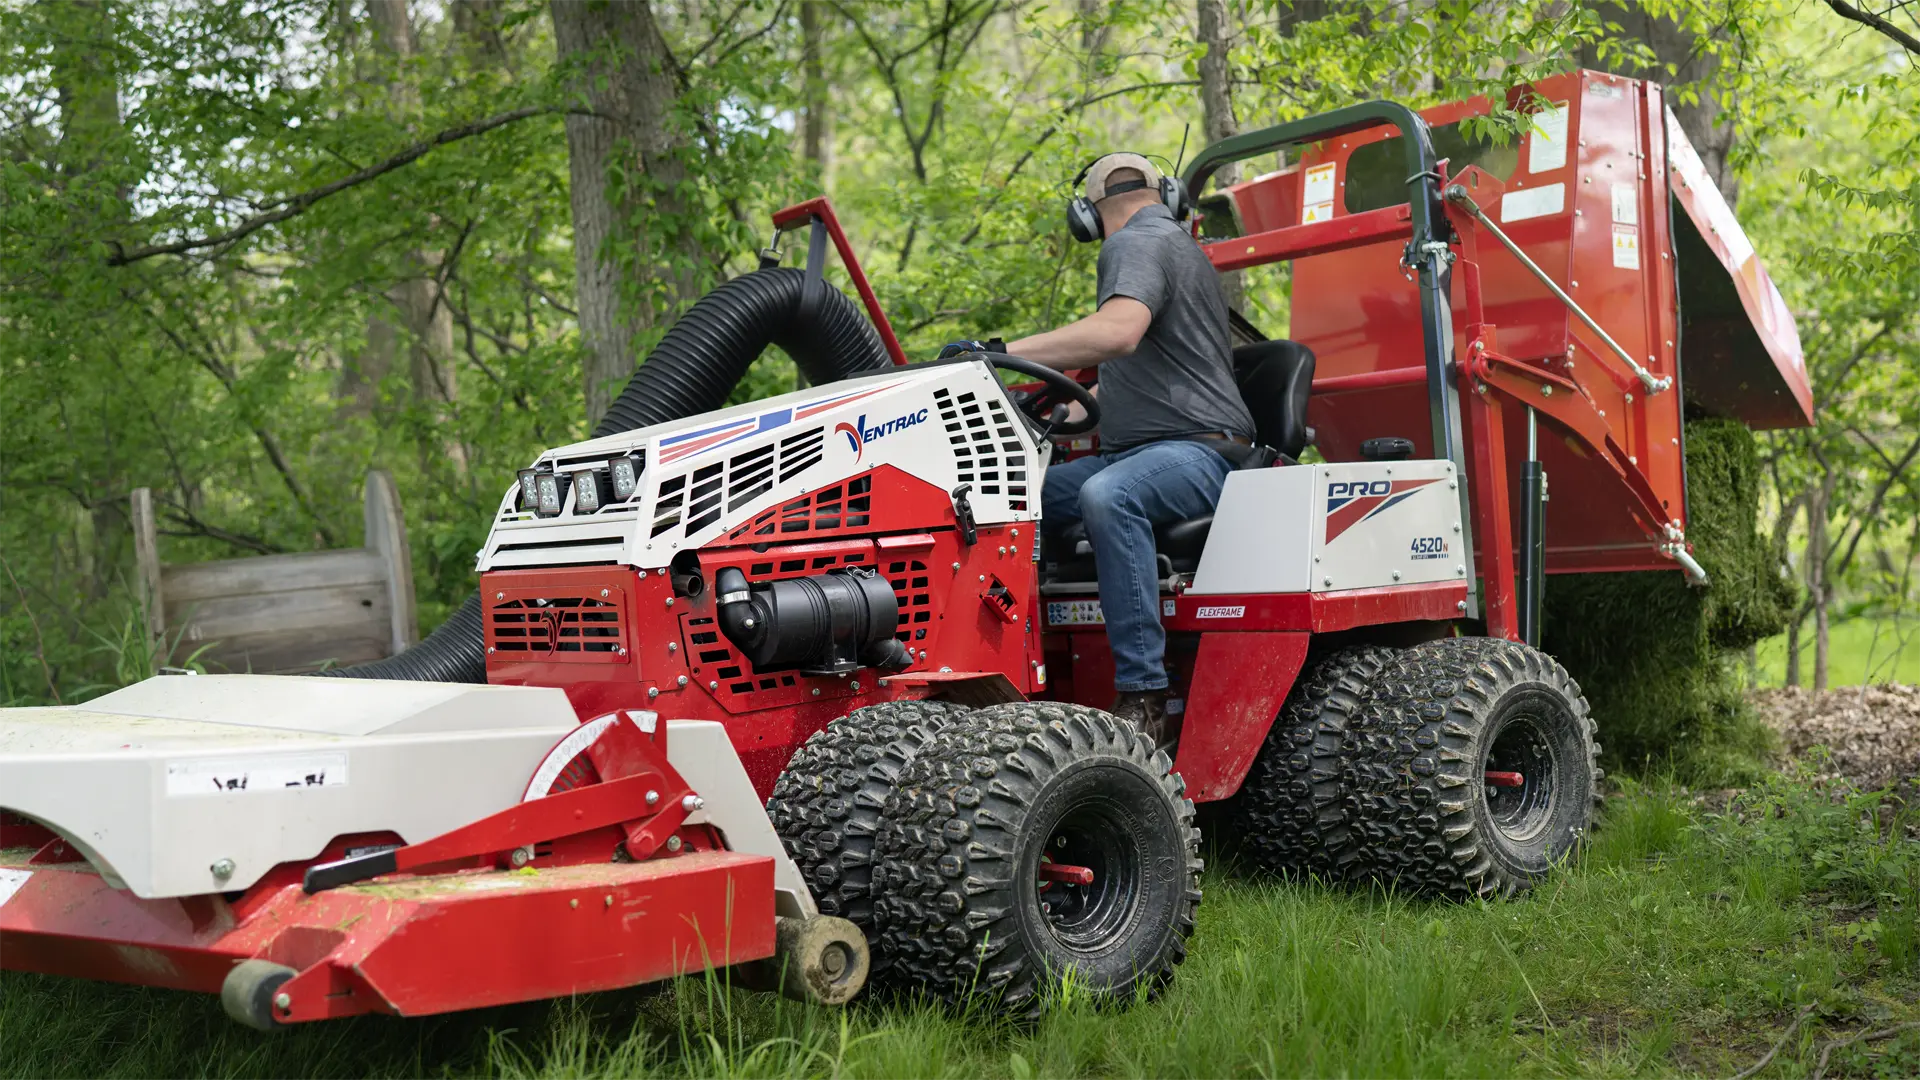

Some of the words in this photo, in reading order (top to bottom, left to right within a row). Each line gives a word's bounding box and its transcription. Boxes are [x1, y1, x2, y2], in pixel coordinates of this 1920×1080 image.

[834, 408, 929, 465] VENTRAC
[1328, 481, 1391, 497] PRO
[1199, 606, 1243, 617] FLEXFRAME
